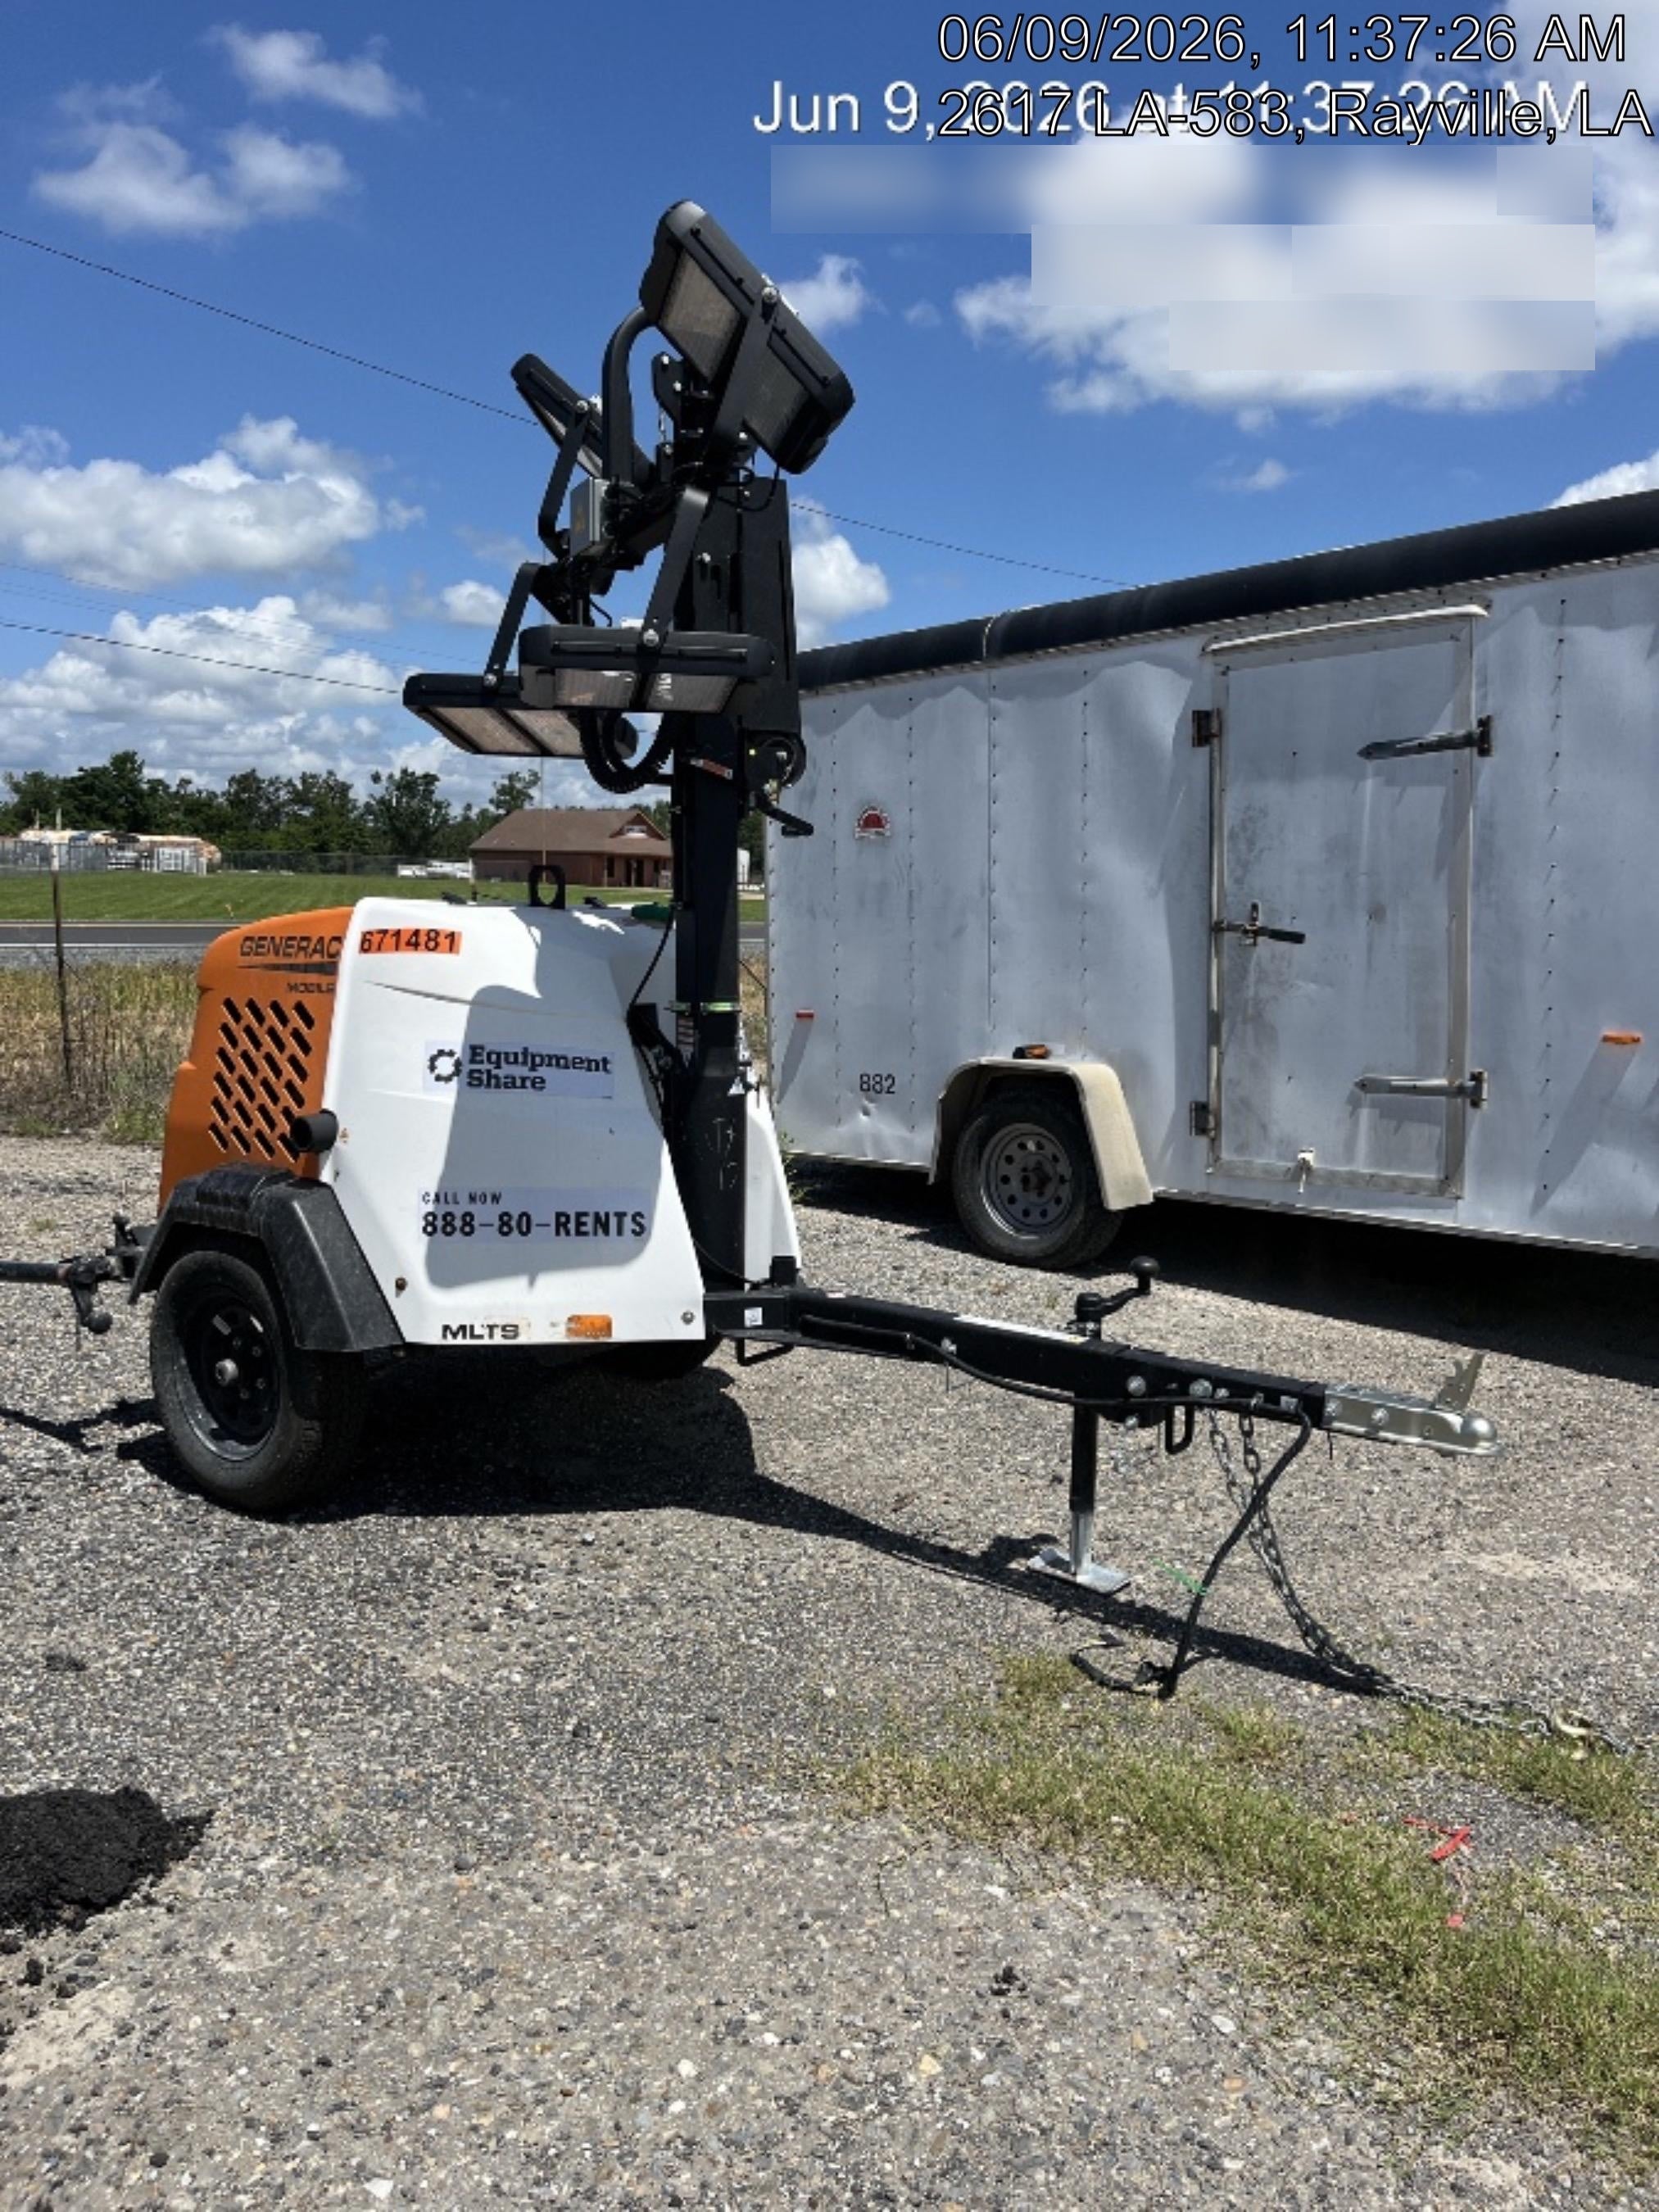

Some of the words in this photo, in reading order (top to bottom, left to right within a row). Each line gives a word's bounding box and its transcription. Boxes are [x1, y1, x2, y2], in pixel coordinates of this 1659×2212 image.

[239, 936, 342, 959] GENERAC
[360, 929, 457, 954] 671481
[468, 1044, 613, 1075] Equipment
[466, 1069, 546, 1091] Share
[859, 1073, 895, 1095] 882
[422, 1192, 460, 1205] CALL
[469, 1192, 502, 1205] NOW
[421, 1211, 646, 1237] 888-80-RENTS
